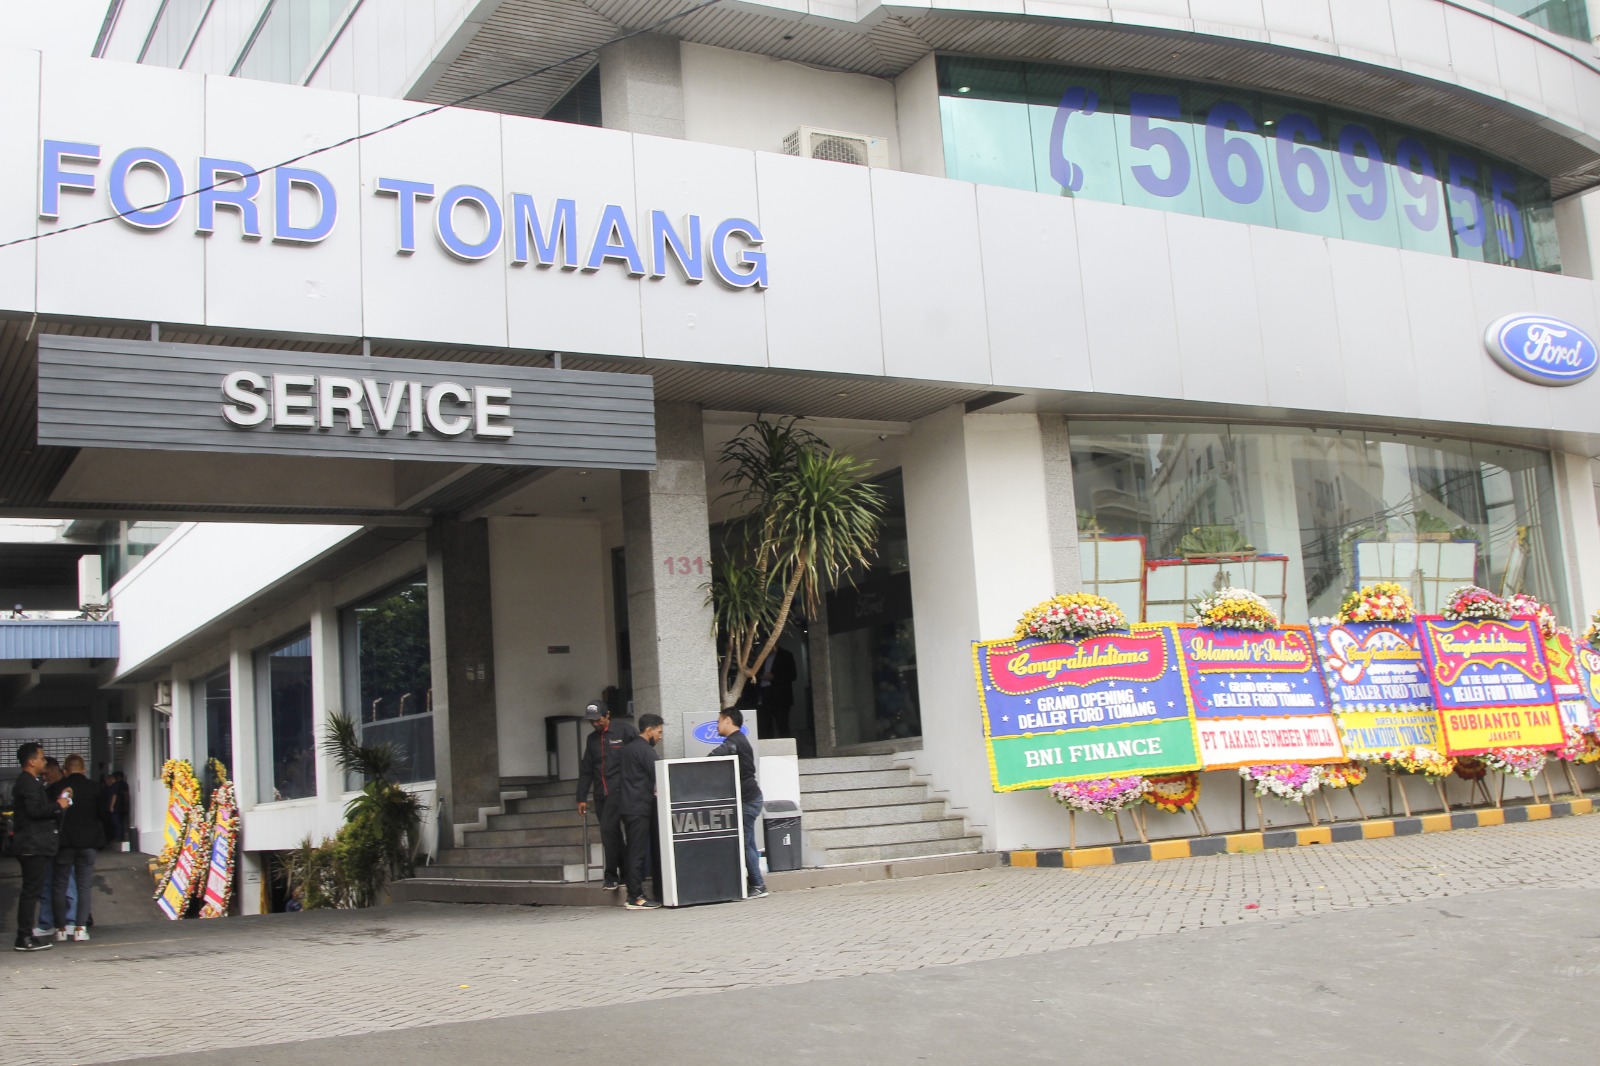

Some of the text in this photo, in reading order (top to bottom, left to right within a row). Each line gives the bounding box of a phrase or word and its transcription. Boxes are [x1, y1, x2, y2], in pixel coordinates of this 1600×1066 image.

[1130, 91, 1524, 260] 5669955
[38, 138, 770, 292] FORD TOMANG
[1523, 323, 1583, 370] Ford
[221, 369, 515, 439] SERVICE
[663, 555, 704, 575] 131
[1007, 643, 1149, 679] Congratulations
[1190, 636, 1250, 660] Selamat
[1264, 638, 1306, 662] Sukses
[1038, 688, 1134, 712] GRAND OPENING
[1212, 694, 1316, 708] DEALER FORD TOMANG
[1342, 684, 1382, 700] DEALER
[1382, 684, 1408, 700] FORD
[1018, 700, 1156, 730] DEALER FORD TOMANG
[1450, 710, 1552, 730] SUBIANTO TAN
[1202, 728, 1334, 750] PT TAKARI SUMBER MULIA
[1488, 730, 1522, 742] JAKARTA
[1024, 737, 1163, 768] BNI FINANCE
[671, 808, 734, 833] VALET
